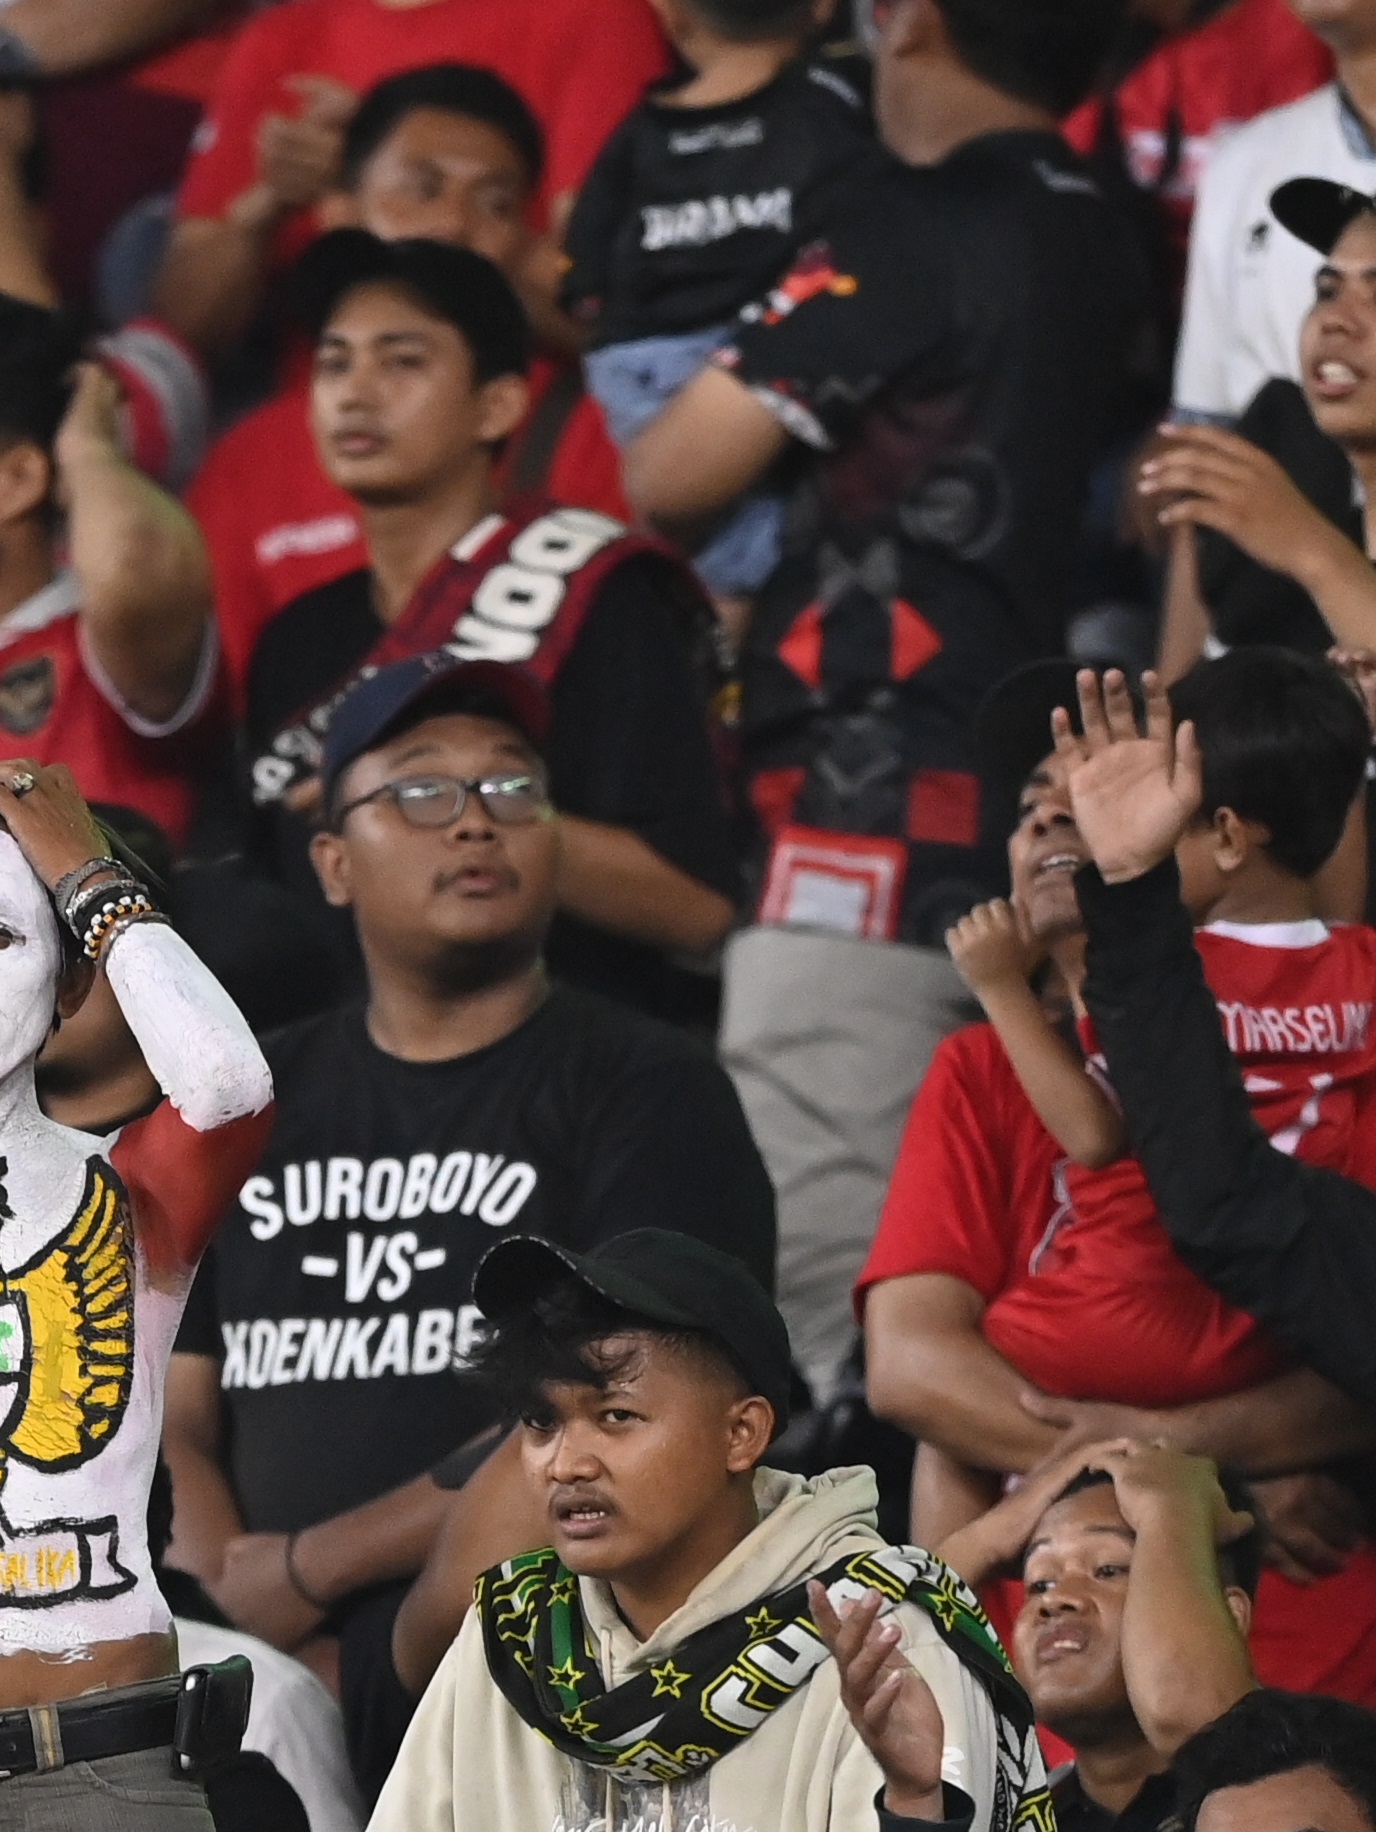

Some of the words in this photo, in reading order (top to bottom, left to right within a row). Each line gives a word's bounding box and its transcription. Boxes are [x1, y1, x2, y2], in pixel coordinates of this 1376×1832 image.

[239, 1150, 538, 1241] SUROBOYO
[221, 1304, 500, 1391] KOENKABE
[36, 1545, 77, 1589] IKA
